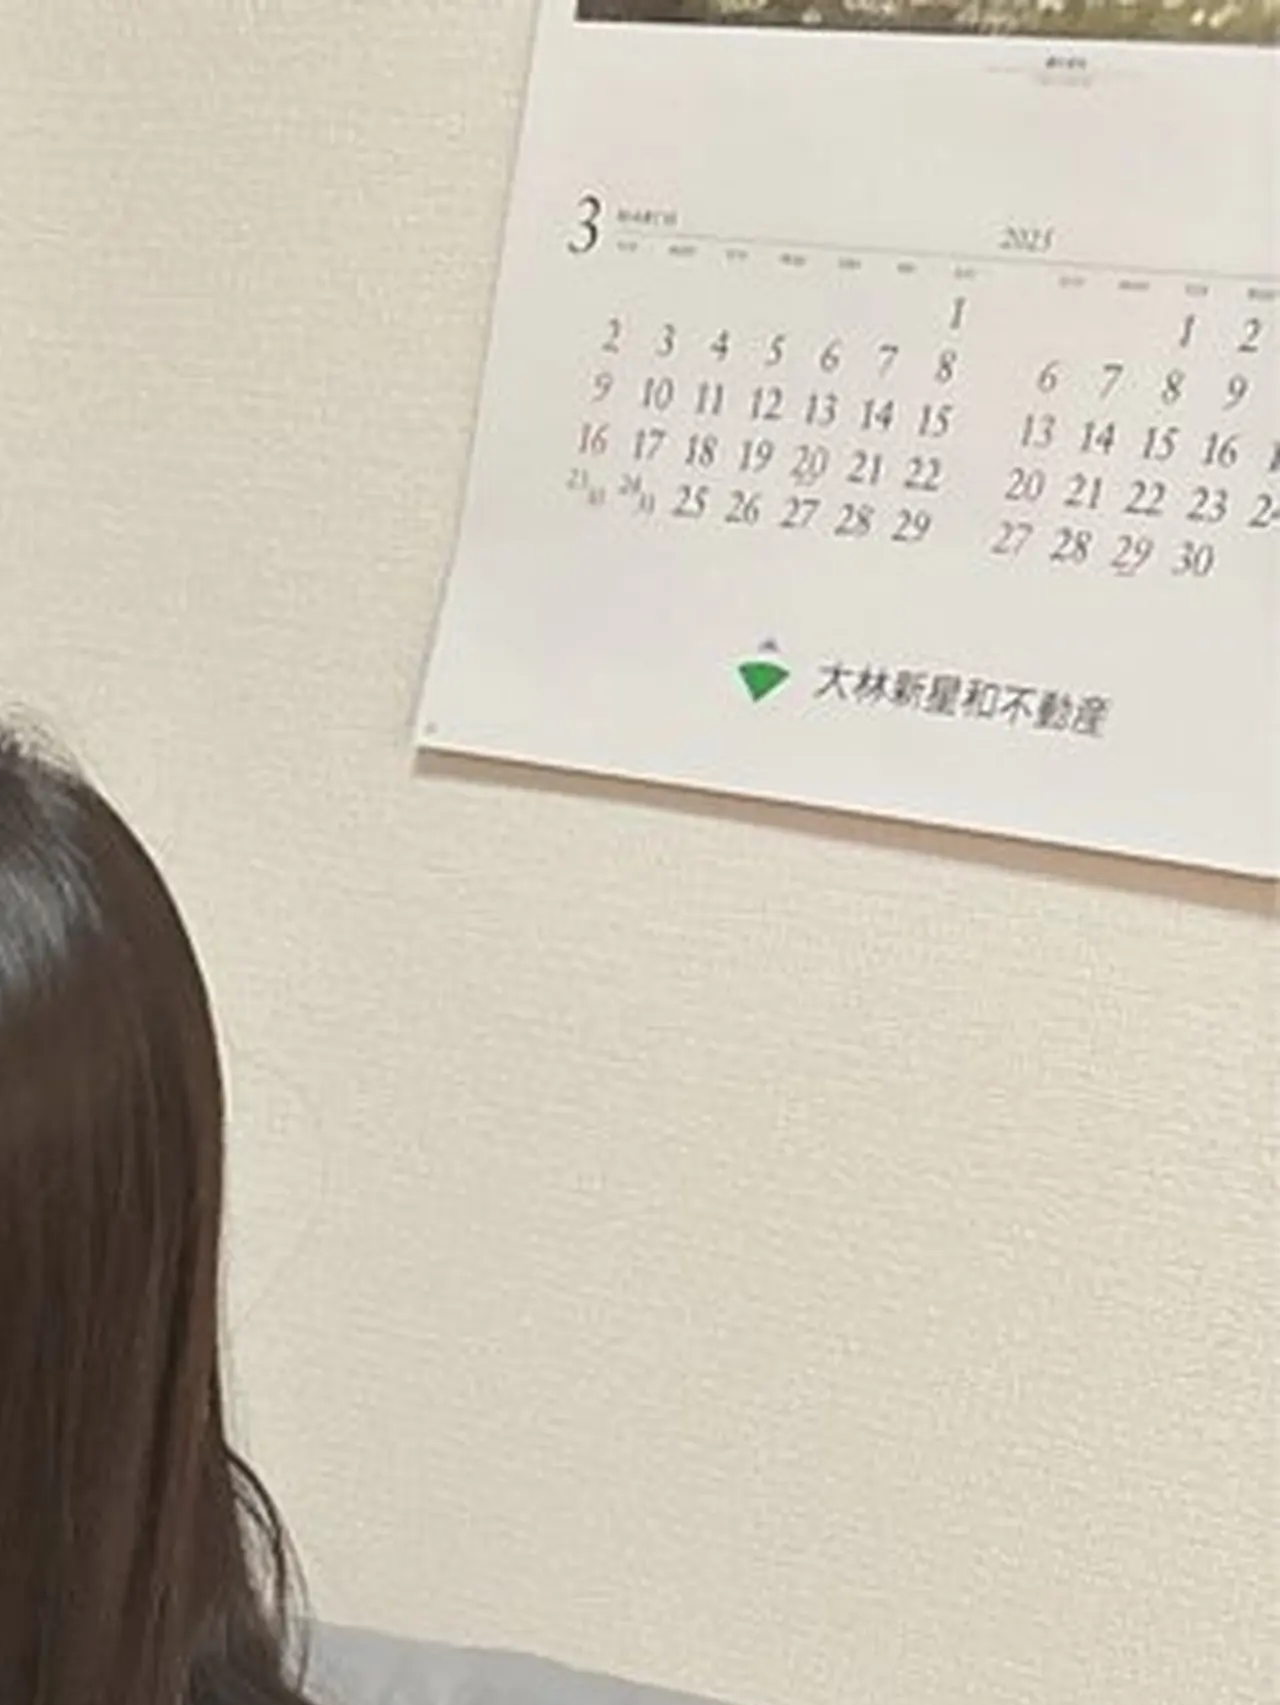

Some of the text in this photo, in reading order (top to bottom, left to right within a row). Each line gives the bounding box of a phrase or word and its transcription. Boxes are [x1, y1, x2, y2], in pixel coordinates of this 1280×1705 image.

[567, 195, 602, 254] 3
[949, 297, 966, 329] 1
[1179, 313, 1262, 353] 1 2
[601, 318, 958, 383] 2 3 4 5 6 7 8
[592, 372, 953, 438] 9 10 11 12 13 14 15
[1037, 360, 1248, 411] 6 7 8 9
[578, 423, 941, 491] 16 17 18 19 20 21 22
[1021, 413, 1057, 448] 13
[1081, 421, 1115, 455] 14
[1143, 427, 1180, 461] 15
[1202, 431, 1239, 468] 16
[671, 485, 710, 518] 25
[725, 490, 761, 525] 26
[779, 498, 821, 528] 27
[834, 504, 875, 537] 28
[891, 509, 932, 542] 29
[1005, 467, 1046, 502] 20
[1063, 473, 1102, 509] 21
[1123, 480, 1167, 516] 22
[1186, 486, 1228, 523] 23
[991, 520, 1215, 577] 27 28 29 30
[813, 660, 1112, 739] 大林新星和不動産
